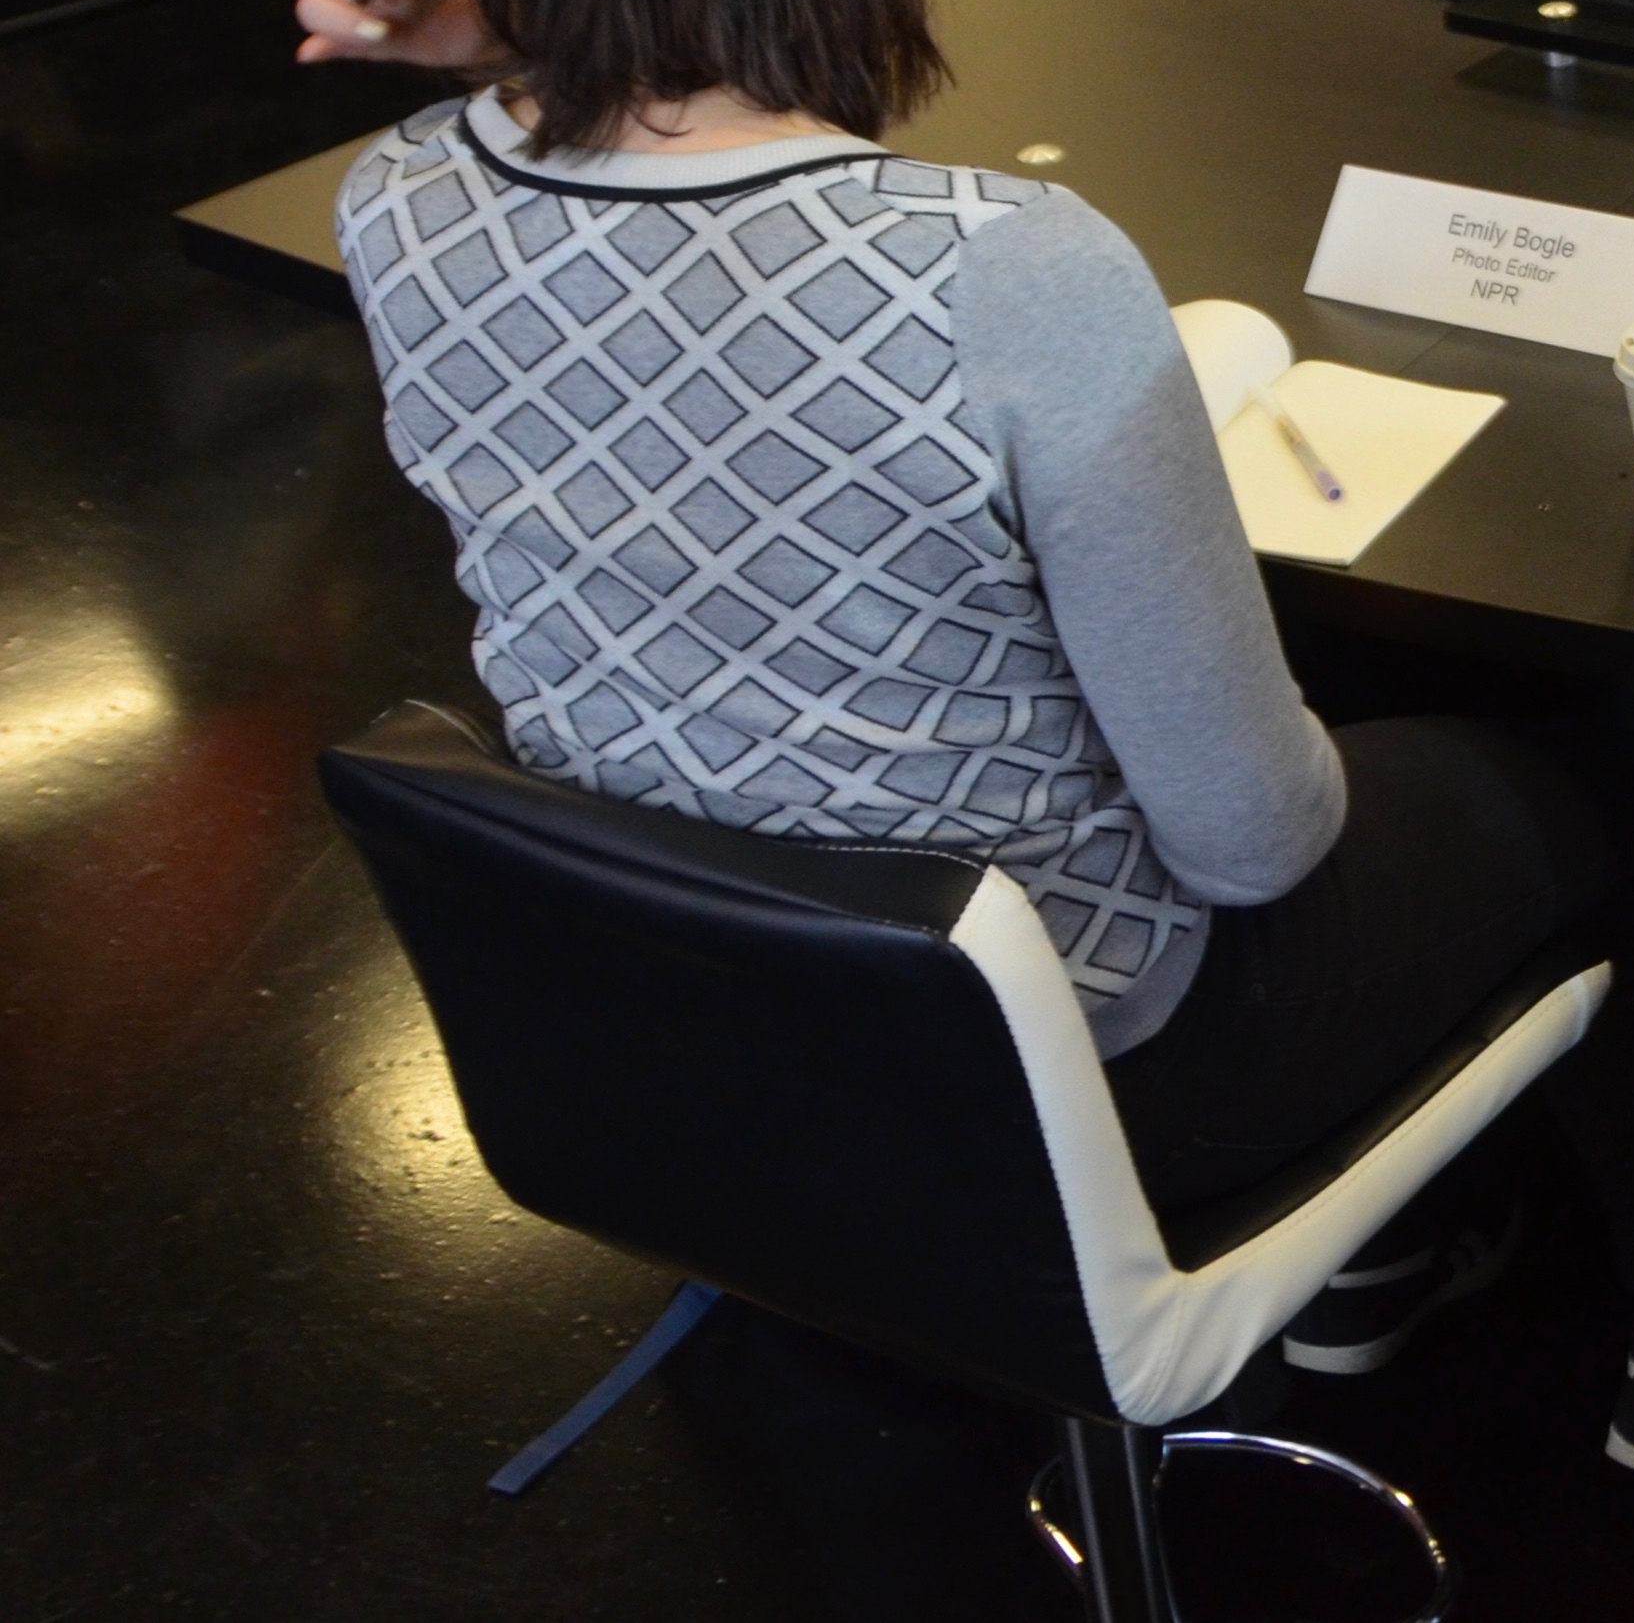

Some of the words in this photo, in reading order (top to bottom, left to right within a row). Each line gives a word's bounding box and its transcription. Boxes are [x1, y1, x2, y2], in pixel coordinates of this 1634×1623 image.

[1447, 213, 1507, 249] Emily
[1514, 227, 1575, 260] Bogle
[1452, 248, 1501, 273] Photo
[1505, 258, 1556, 283] Editor
[1470, 279, 1519, 305] NPR
